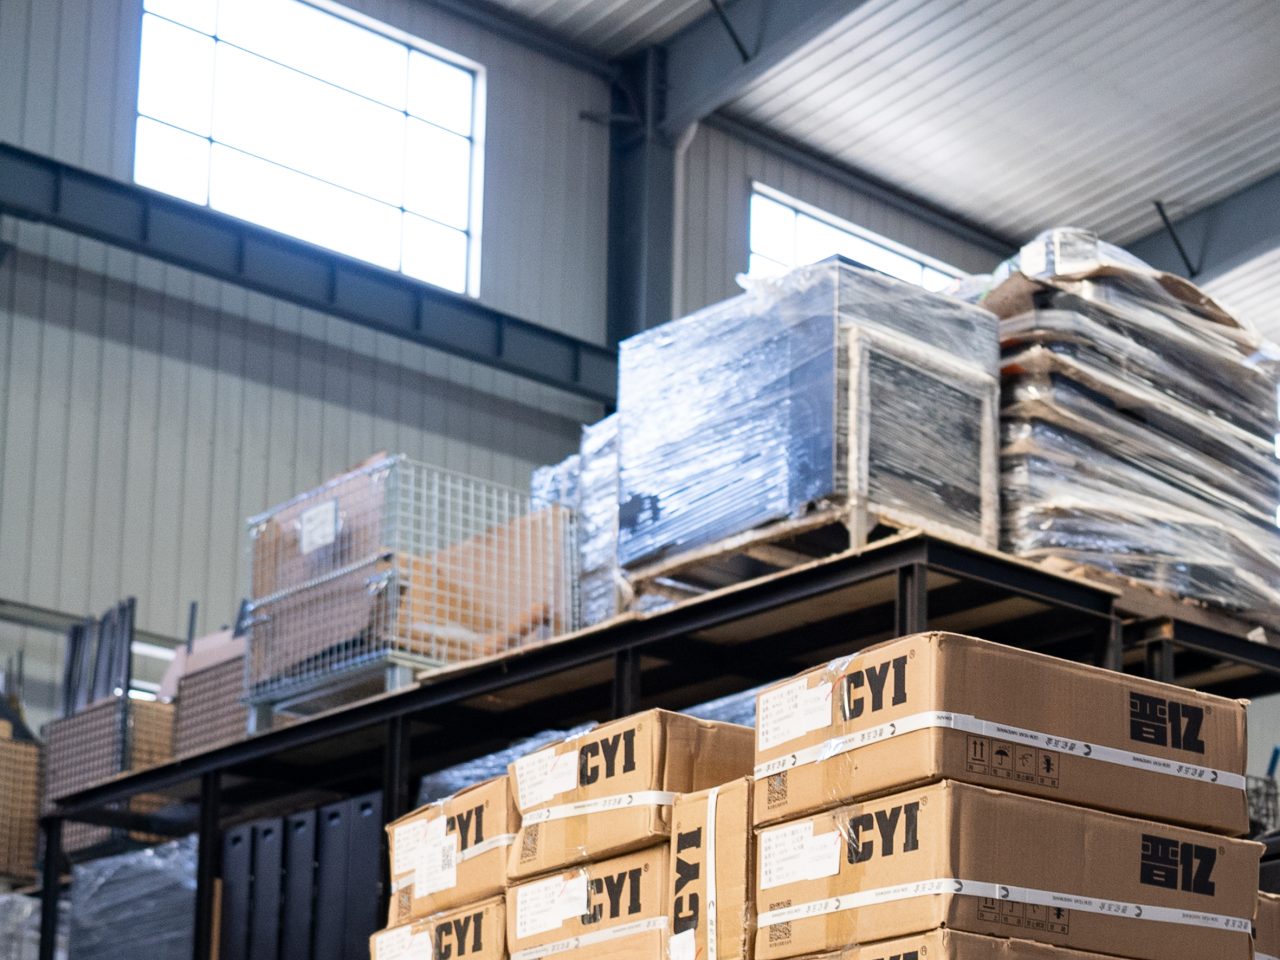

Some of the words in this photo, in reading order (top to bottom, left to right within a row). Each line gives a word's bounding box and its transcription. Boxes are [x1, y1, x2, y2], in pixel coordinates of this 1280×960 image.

[842, 655, 907, 721] CYI
[1130, 691, 1204, 754] 晋亿
[580, 729, 635, 787] CYI
[847, 801, 919, 864] CYI
[581, 867, 642, 925] CYI
[673, 827, 701, 934] CYI
[1140, 833, 1215, 896] 晋亿
